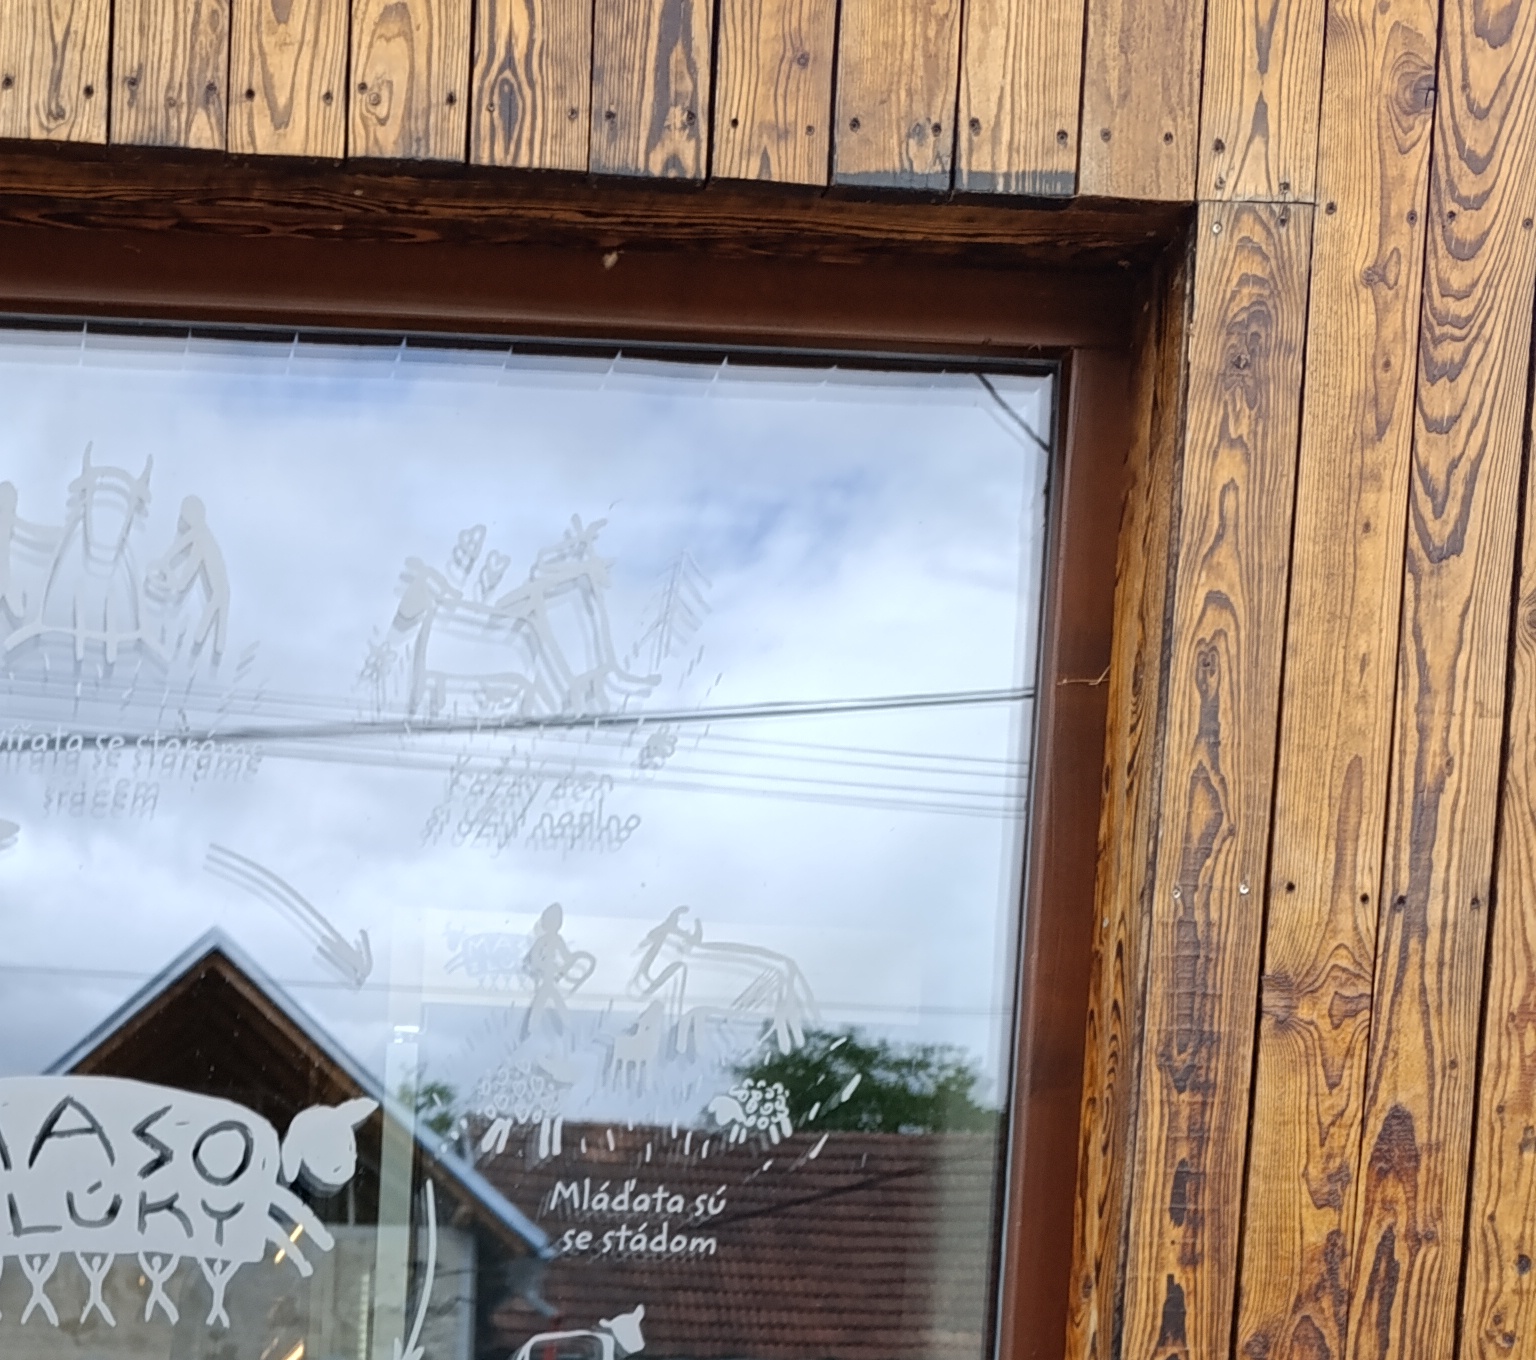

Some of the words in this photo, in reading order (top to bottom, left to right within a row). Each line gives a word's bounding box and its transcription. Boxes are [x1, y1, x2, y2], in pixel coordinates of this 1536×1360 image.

[96, 734, 125, 754] se
[6, 1180, 247, 1250] LÚKY
[549, 1176, 686, 1213] Mláďata
[694, 1184, 728, 1217] sú
[561, 1227, 594, 1253] se
[601, 1220, 718, 1256] stádom
